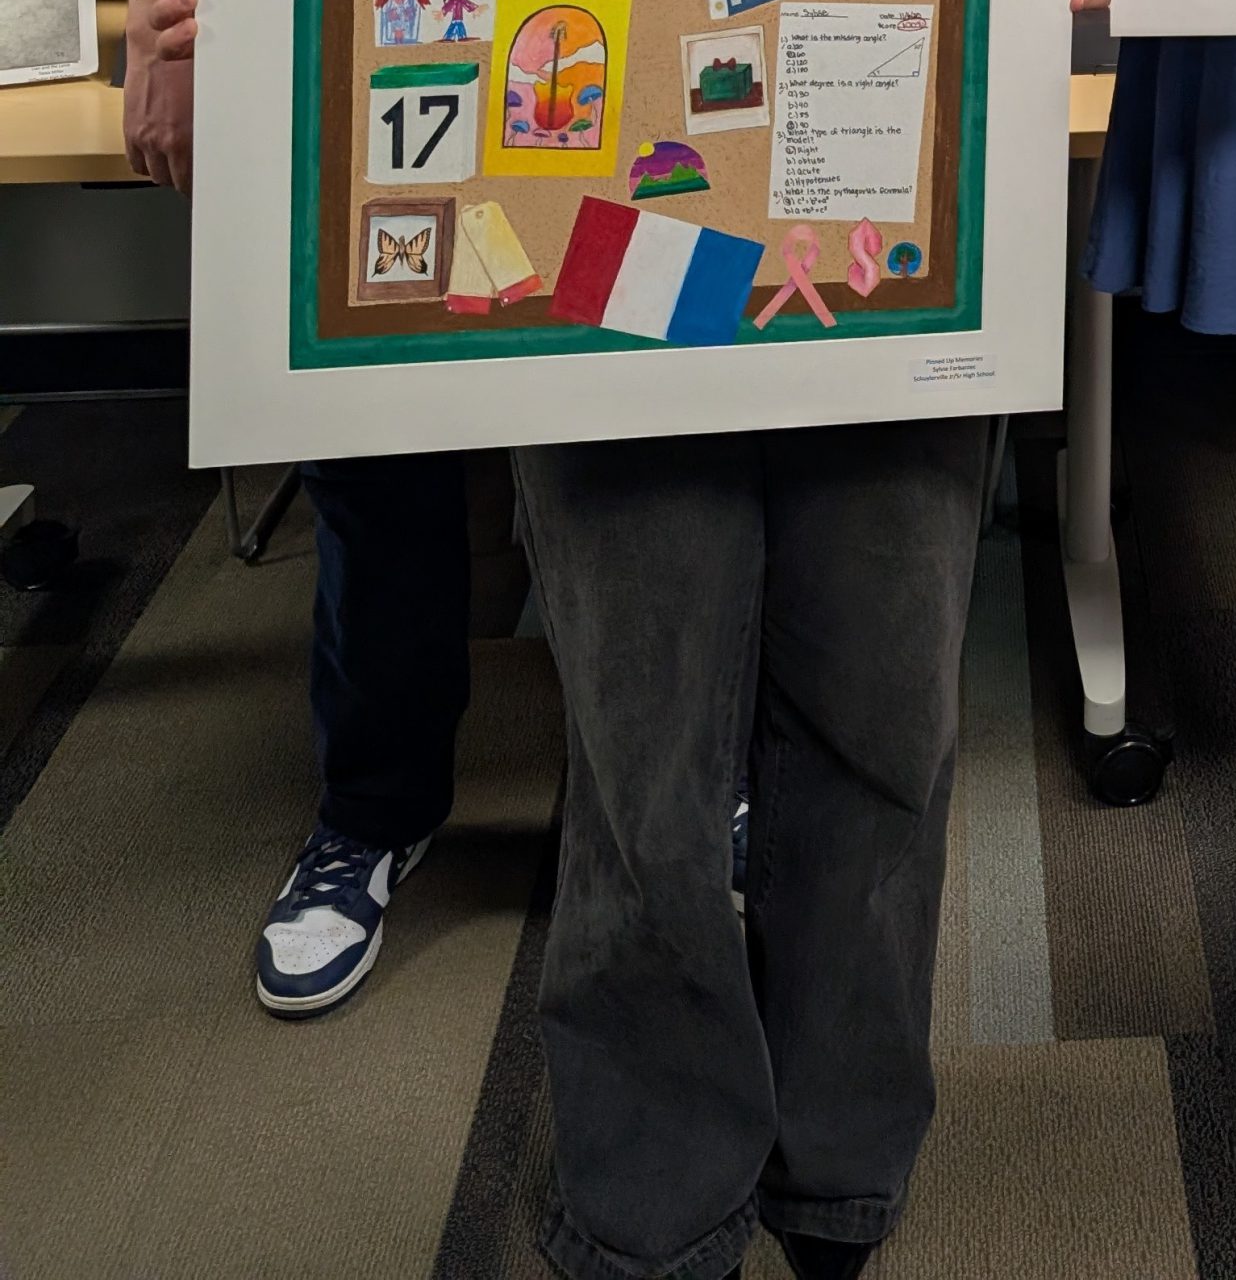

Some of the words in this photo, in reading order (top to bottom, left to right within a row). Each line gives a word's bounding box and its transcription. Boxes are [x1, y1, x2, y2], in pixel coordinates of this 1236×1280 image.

[791, 33, 809, 41] What
[820, 33, 832, 41] the
[789, 79, 807, 88] What
[809, 79, 834, 91] degree
[855, 79, 873, 90] right
[381, 94, 460, 170] 17
[787, 128, 808, 136] What
[811, 128, 828, 138] type
[840, 125, 873, 138] triangle
[887, 125, 902, 135] the
[797, 145, 819, 157] Right
[797, 166, 821, 176] acute
[784, 187, 804, 196] What
